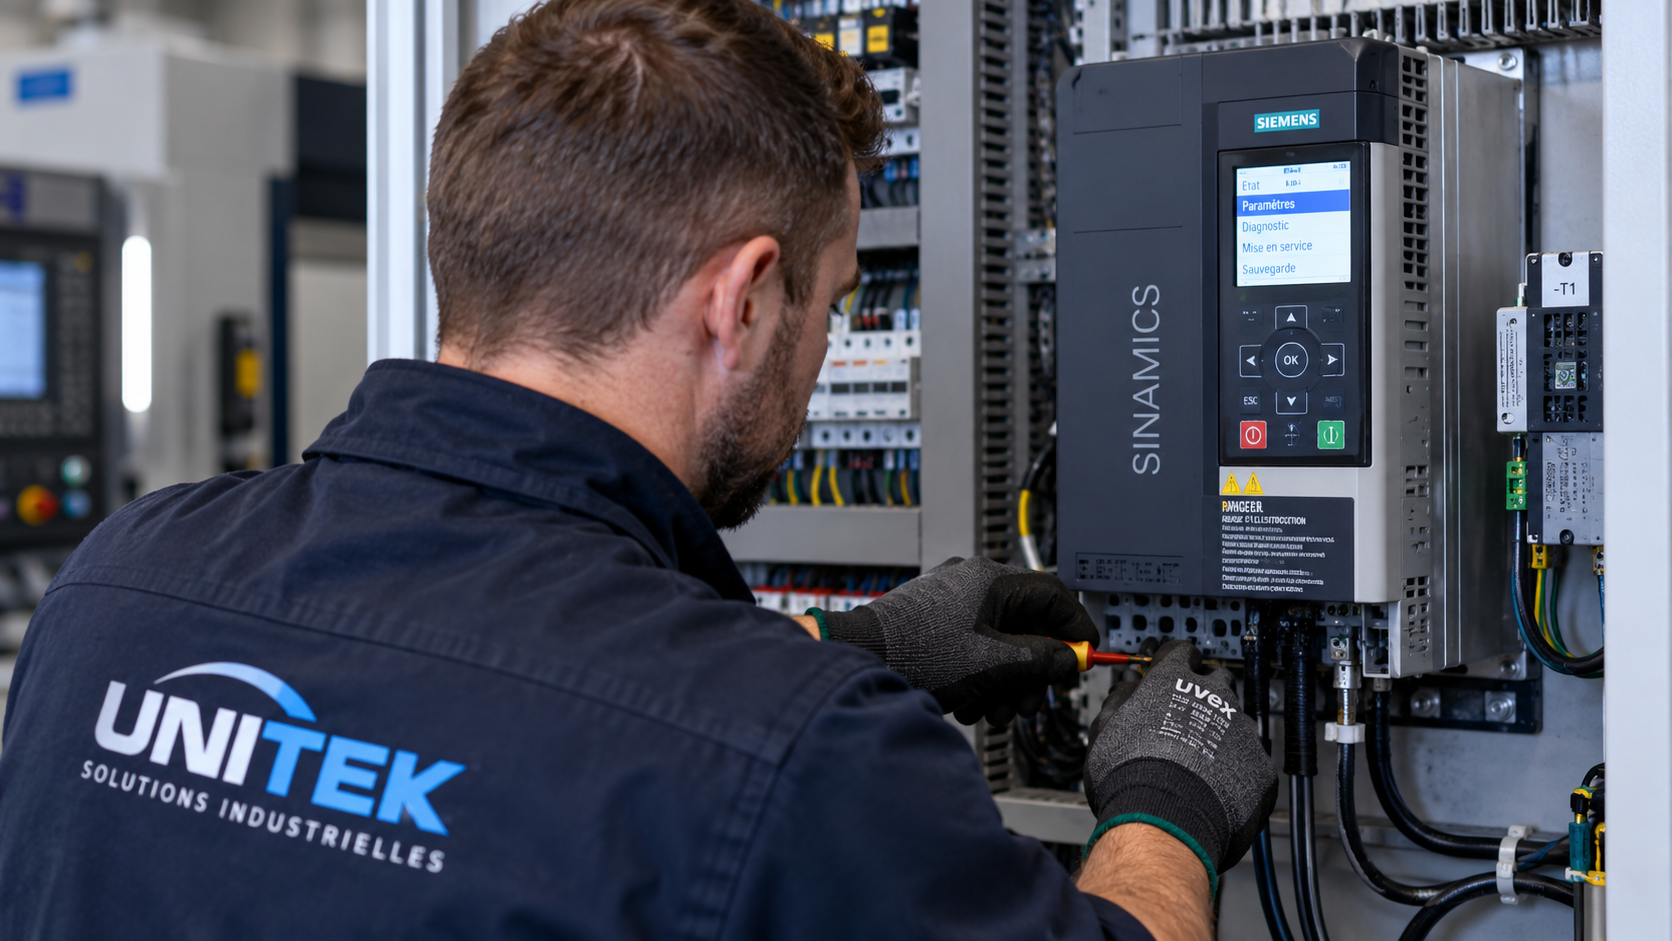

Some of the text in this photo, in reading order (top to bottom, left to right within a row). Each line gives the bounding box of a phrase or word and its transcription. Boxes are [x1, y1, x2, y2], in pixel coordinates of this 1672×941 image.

[1257, 113, 1317, 129] SIEMENS
[1242, 180, 1260, 191] Etat
[1242, 220, 1290, 234] Diagnostic
[1242, 240, 1313, 254] Mise en service
[1242, 262, 1296, 277] Sauvegarde
[1553, 282, 1577, 296] -T1
[1283, 355, 1299, 366] OK
[1132, 284, 1161, 475] SINAMICS
[1243, 396, 1258, 406] ESC
[1175, 678, 1236, 720] uvex
[95, 680, 467, 837] UNITEK
[81, 760, 446, 874] SOLUTIONS INDUSTRIELLES
